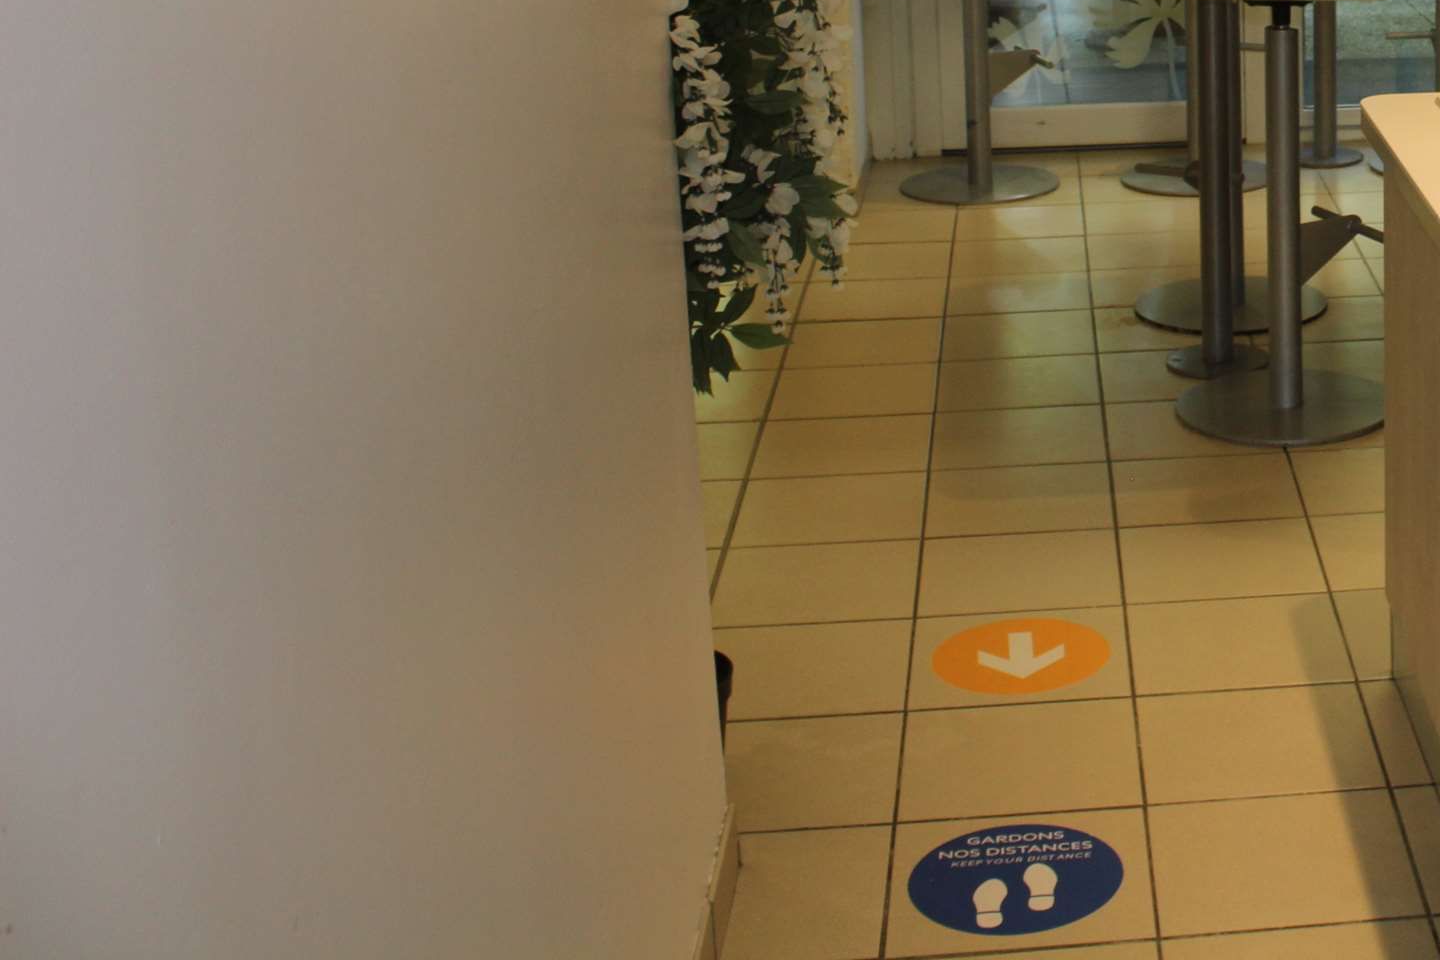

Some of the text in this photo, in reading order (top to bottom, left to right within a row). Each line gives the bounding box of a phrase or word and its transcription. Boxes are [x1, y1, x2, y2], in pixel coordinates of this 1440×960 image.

[967, 830, 1065, 846] GARDONS
[938, 840, 1093, 861] NOS DISTANCES
[951, 851, 1092, 868] KEEP YOUR DISTANCE
